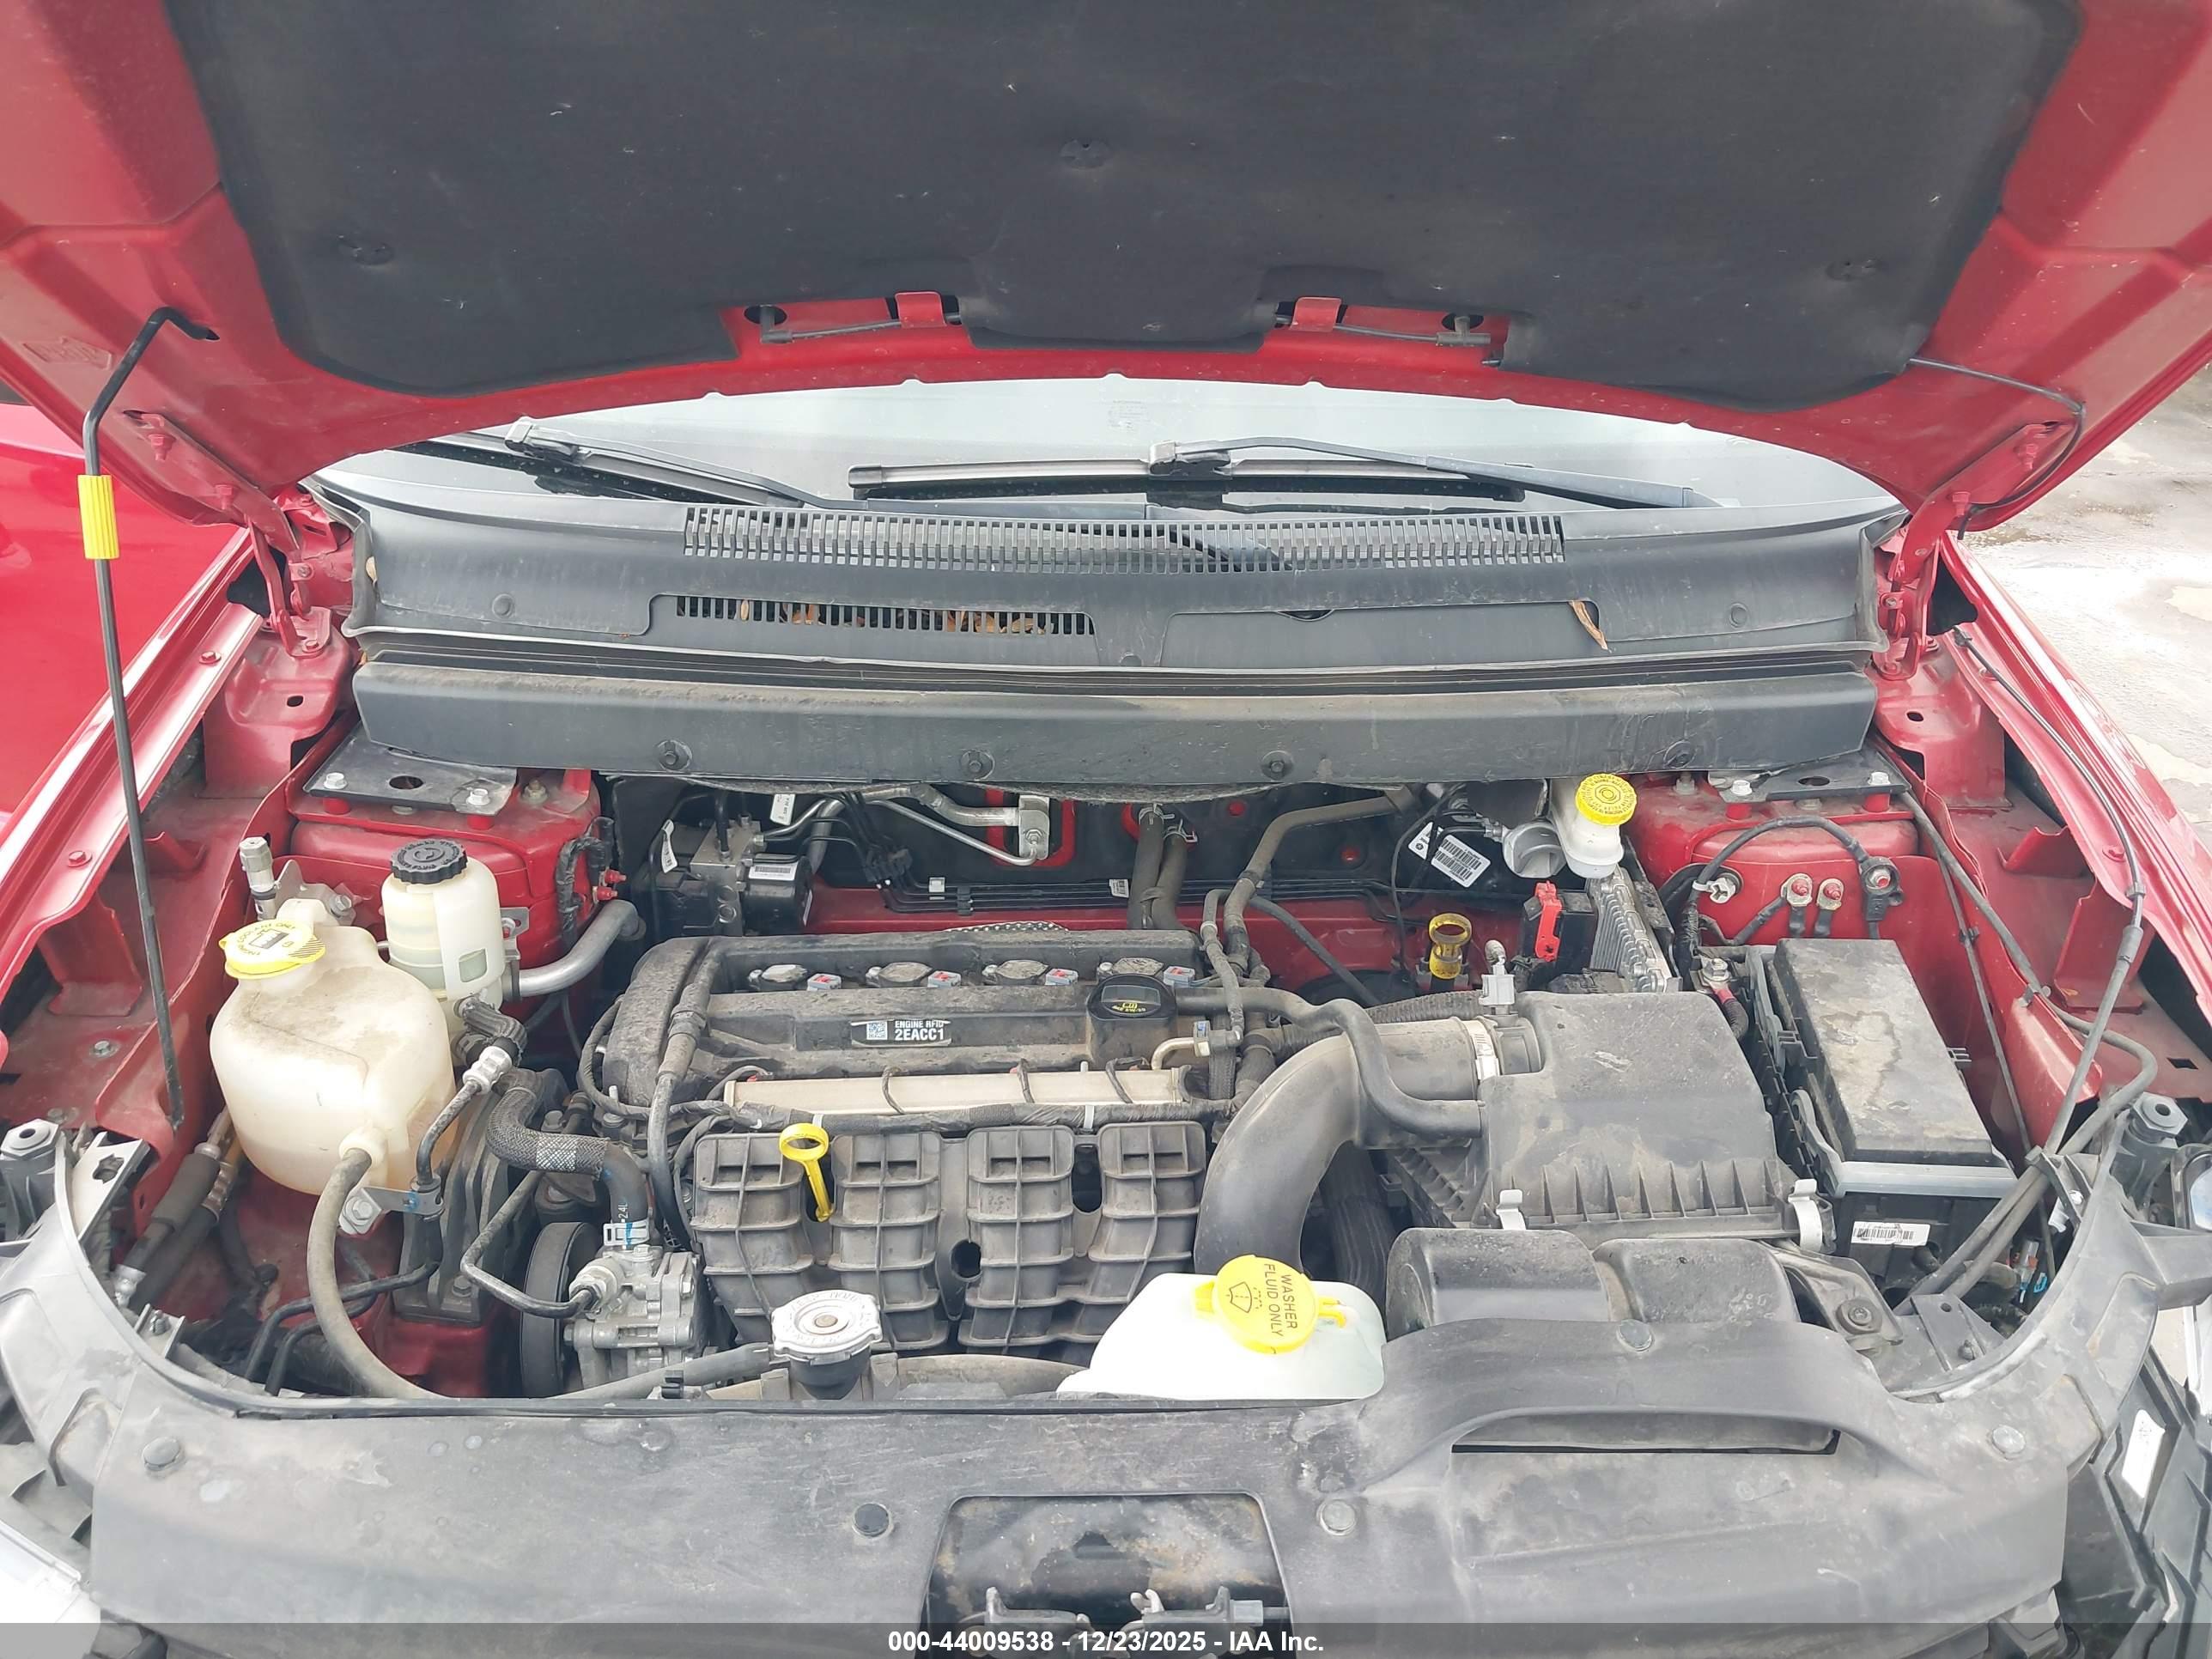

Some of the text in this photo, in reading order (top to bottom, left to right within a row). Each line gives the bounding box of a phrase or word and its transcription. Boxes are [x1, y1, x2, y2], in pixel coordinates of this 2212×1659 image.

[894, 1028, 944, 1041] 2EACC1
[895, 1020, 944, 1029] ENGINE RFID
[1264, 1263, 1285, 1337] FLUID ONLY
[1280, 1274, 1298, 1329] WASHER
